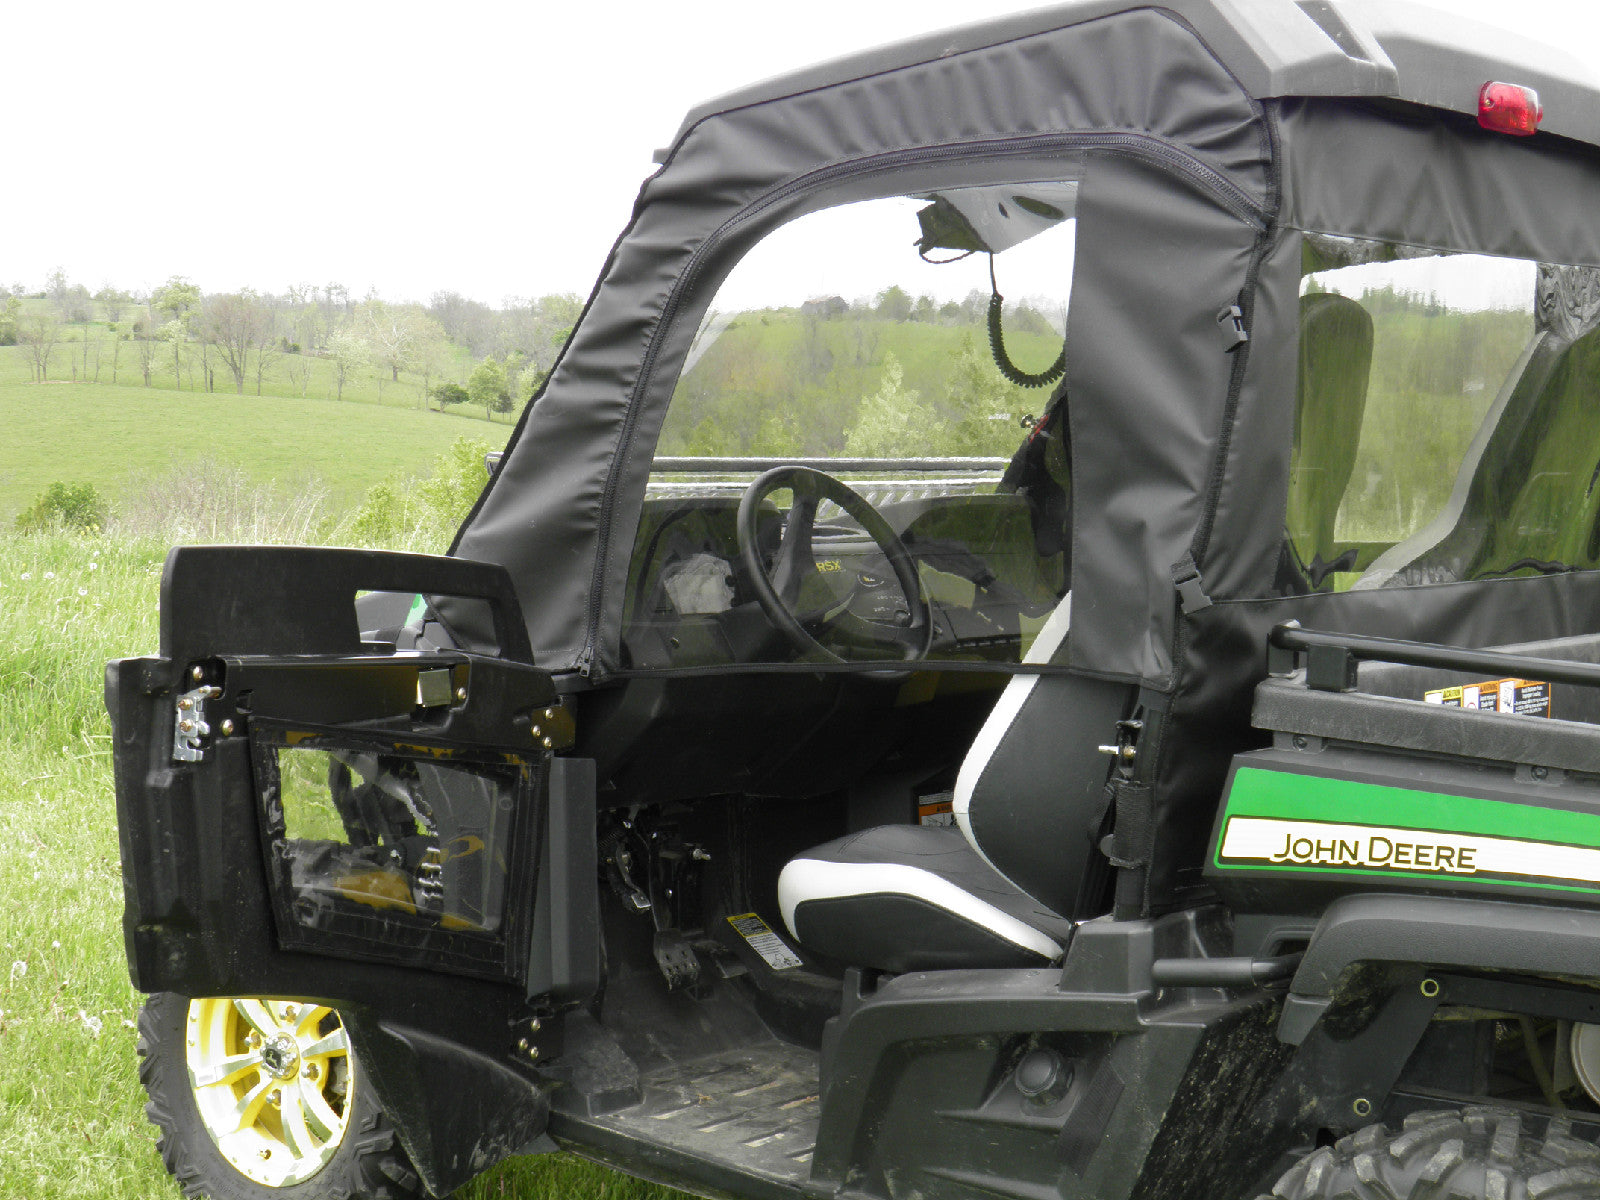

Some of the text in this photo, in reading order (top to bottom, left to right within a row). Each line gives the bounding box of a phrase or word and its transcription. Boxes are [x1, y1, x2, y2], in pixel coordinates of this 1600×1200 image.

[816, 560, 841, 572] RSX
[1274, 833, 1477, 869] JOHN DEERE
